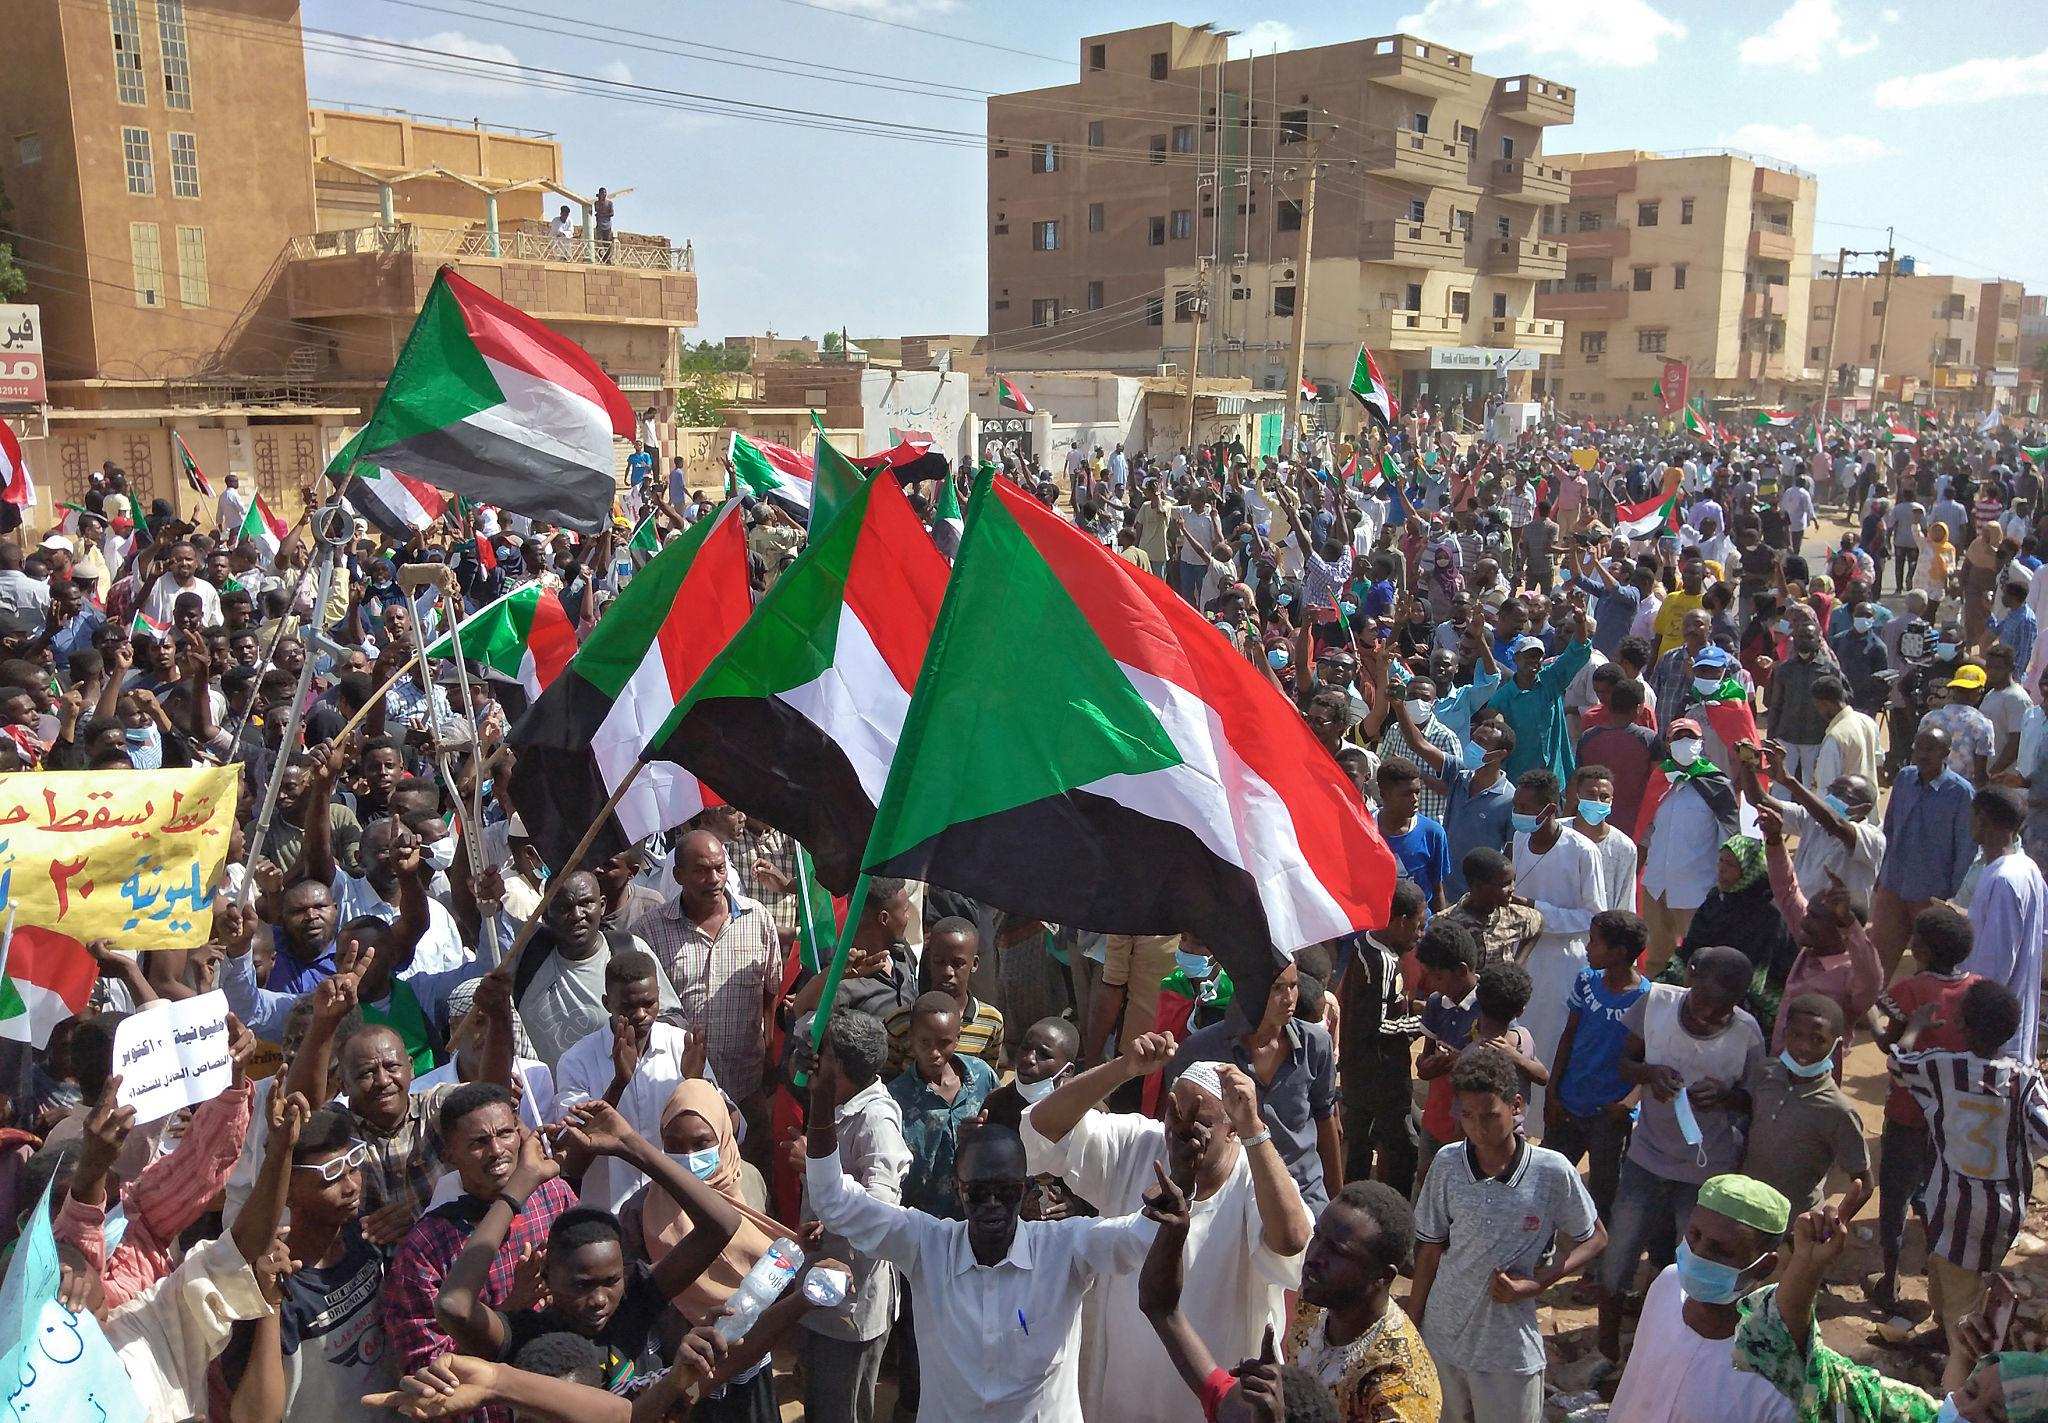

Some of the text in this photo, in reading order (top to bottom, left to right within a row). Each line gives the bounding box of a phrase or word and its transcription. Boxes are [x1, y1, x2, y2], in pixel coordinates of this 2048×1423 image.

[37, 786, 154, 840] يسقط
[1606, 1007, 1623, 1022] YO
[172, 1018, 225, 1045] مليونية
